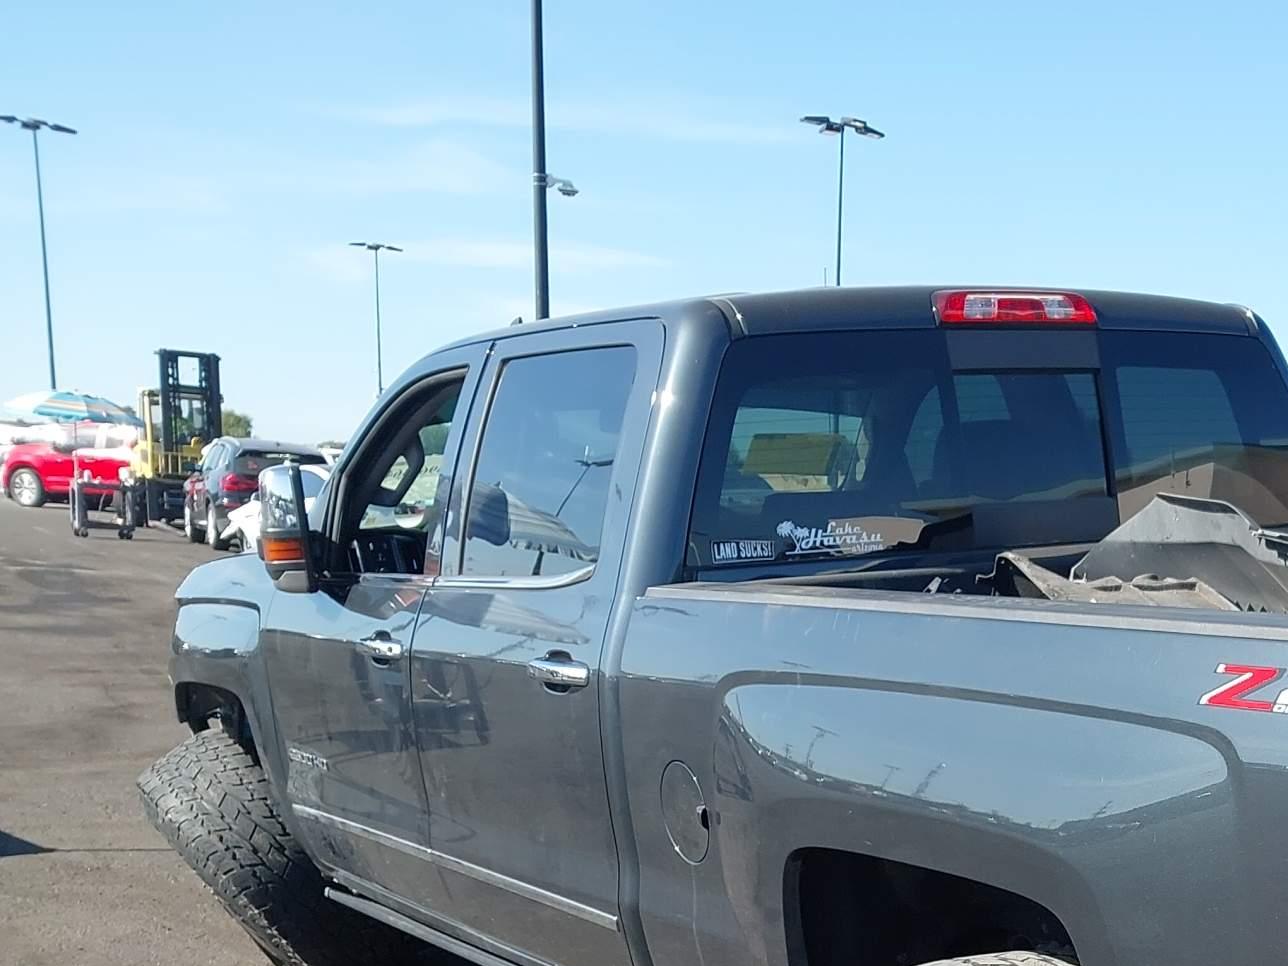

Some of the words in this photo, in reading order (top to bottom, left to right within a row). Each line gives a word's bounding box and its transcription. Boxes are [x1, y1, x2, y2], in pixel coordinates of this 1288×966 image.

[823, 520, 862, 537] Lake
[801, 528, 884, 549] Havasu
[714, 542, 738, 560] LAND
[740, 541, 773, 559] SUCKS!
